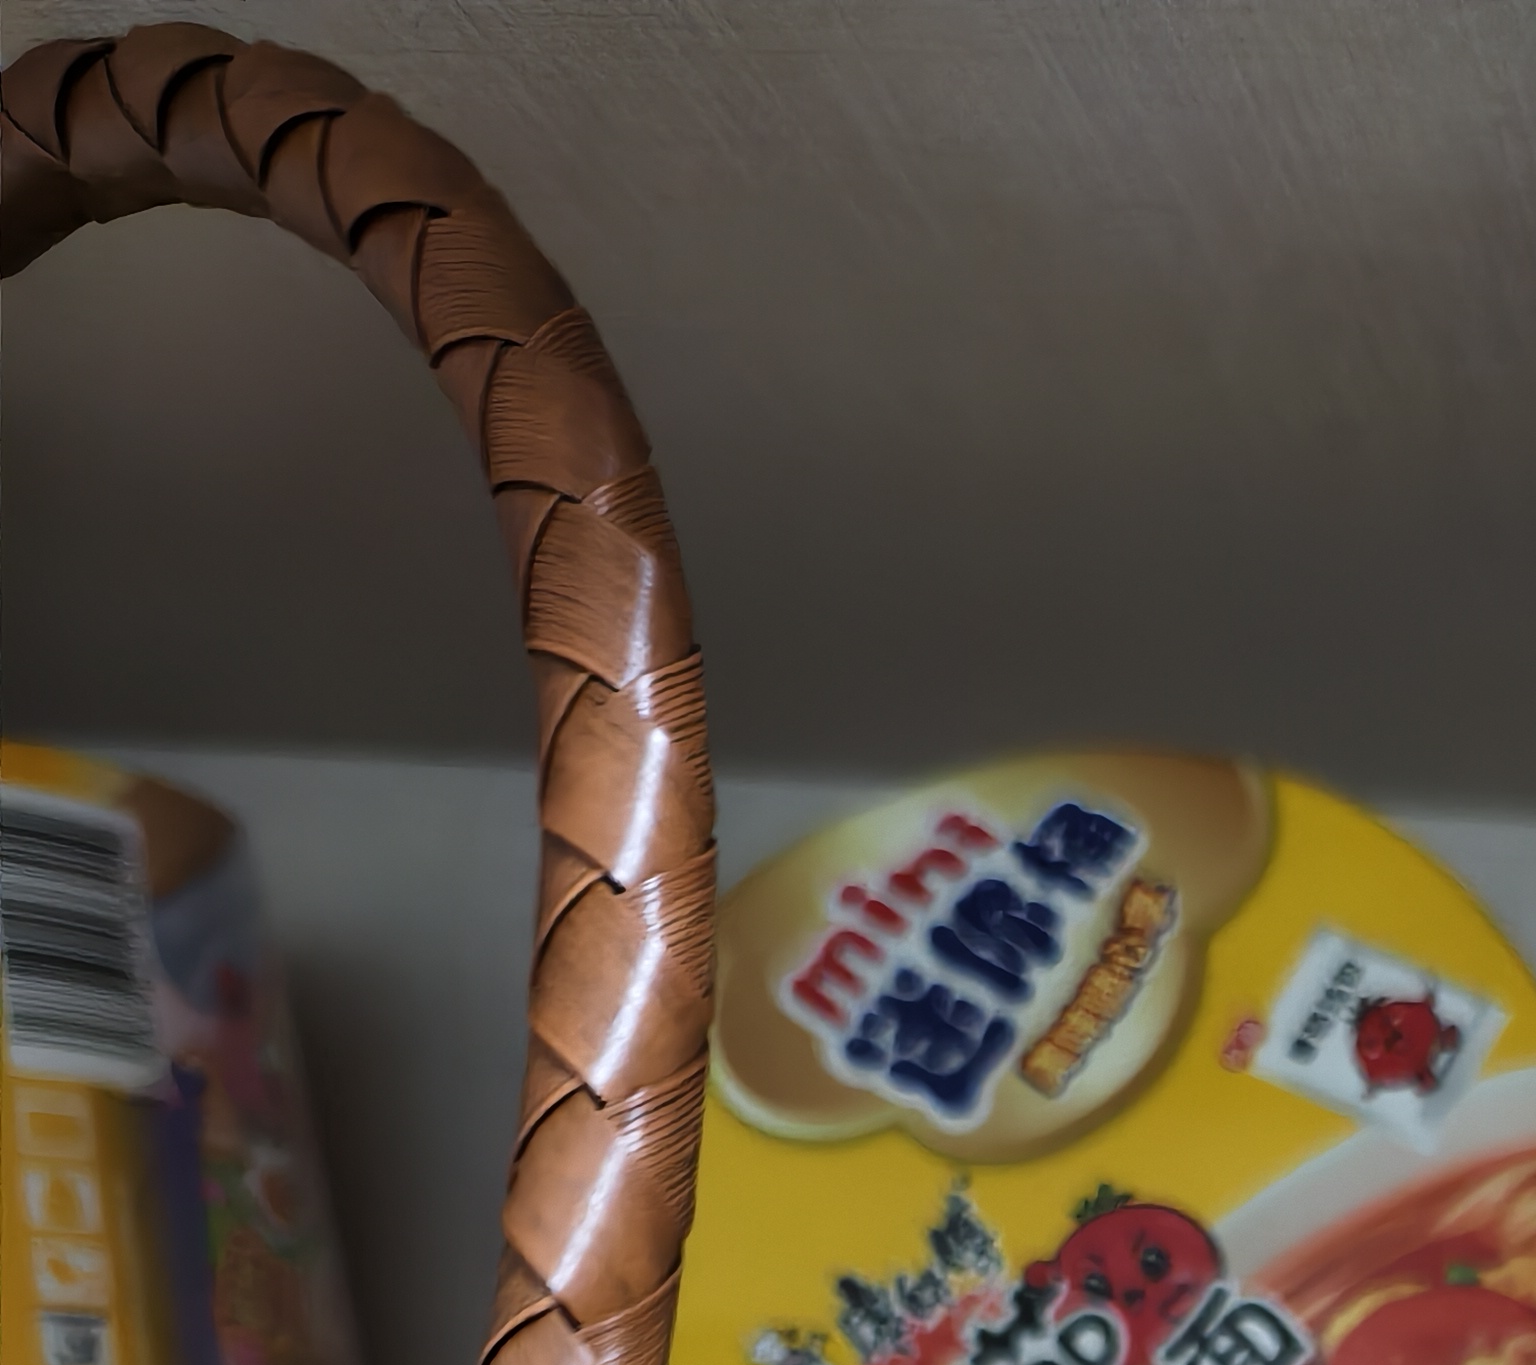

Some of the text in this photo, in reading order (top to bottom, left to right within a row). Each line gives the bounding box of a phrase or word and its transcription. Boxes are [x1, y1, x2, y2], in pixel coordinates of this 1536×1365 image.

[791, 813, 1001, 1029] mini
[844, 801, 1140, 1117] 迷你桶
